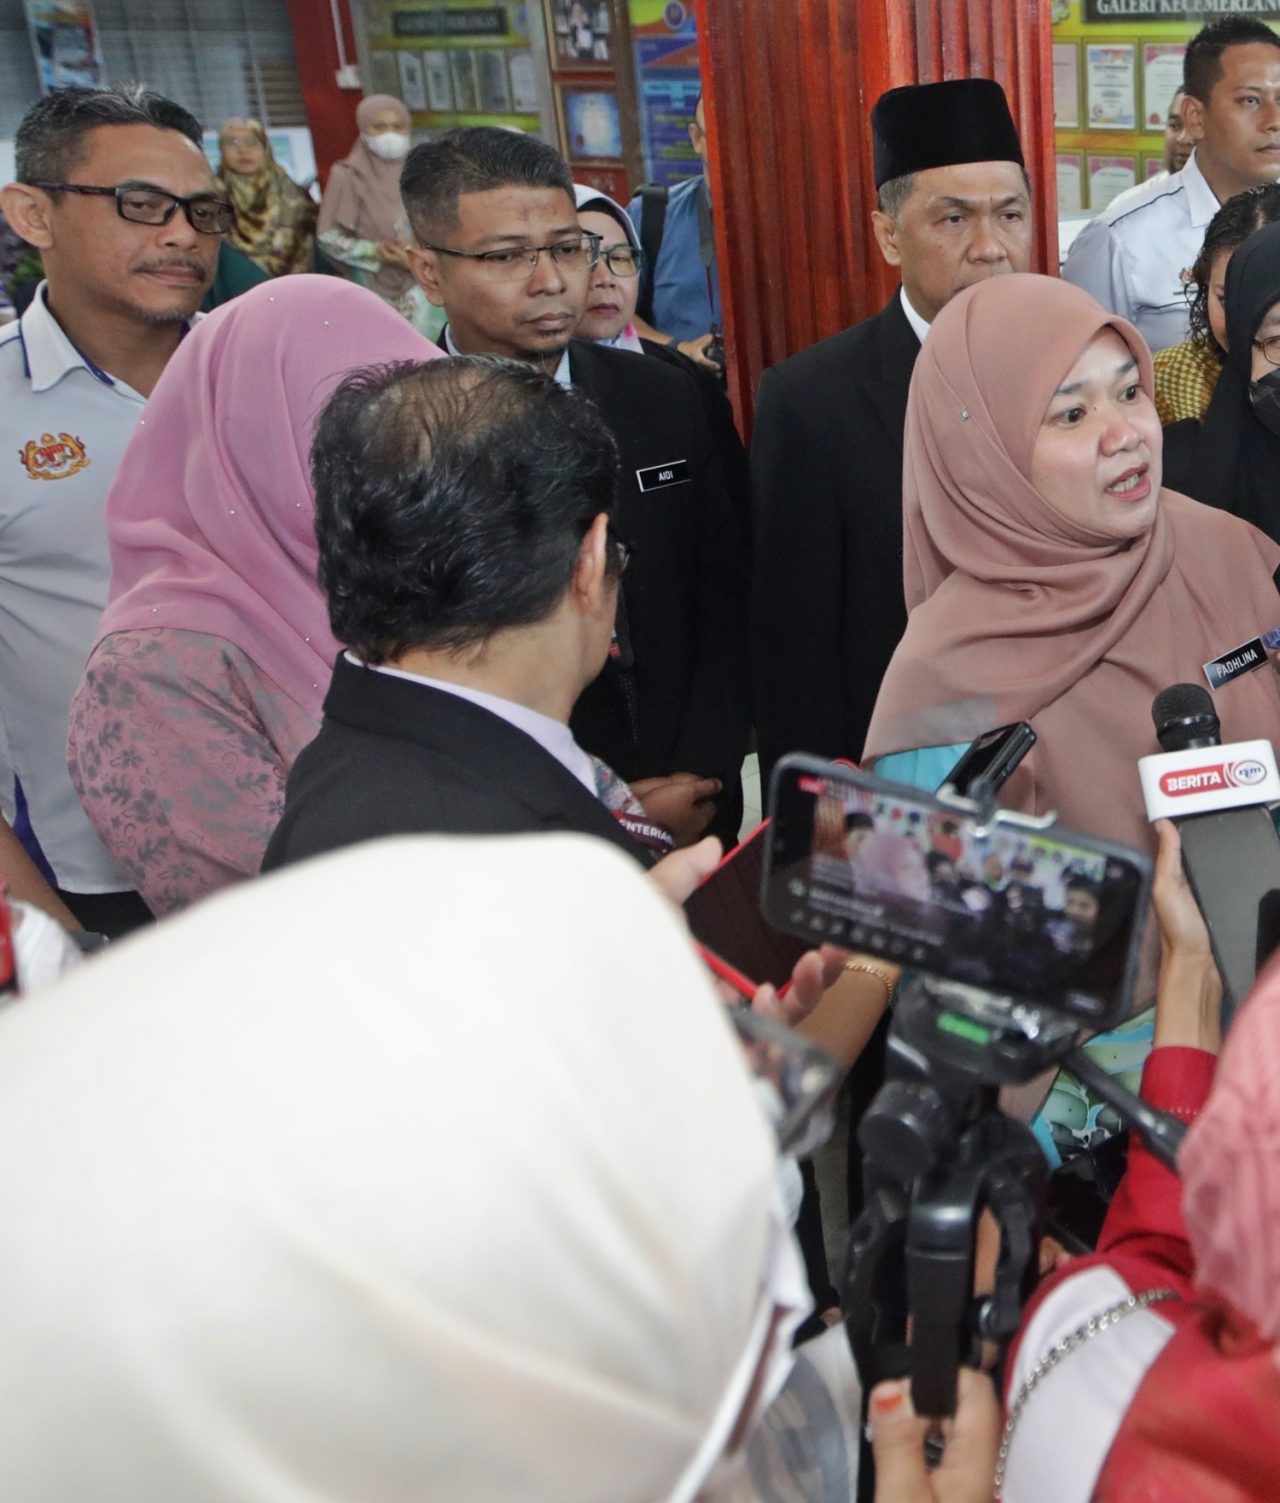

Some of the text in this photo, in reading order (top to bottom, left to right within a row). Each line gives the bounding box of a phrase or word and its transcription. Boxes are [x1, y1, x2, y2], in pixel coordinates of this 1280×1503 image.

[1097, 0, 1157, 14] GALERI
[658, 470, 674, 481] AIDI
[1216, 648, 1258, 679] FADHLINA
[1167, 771, 1222, 792] BERITA
